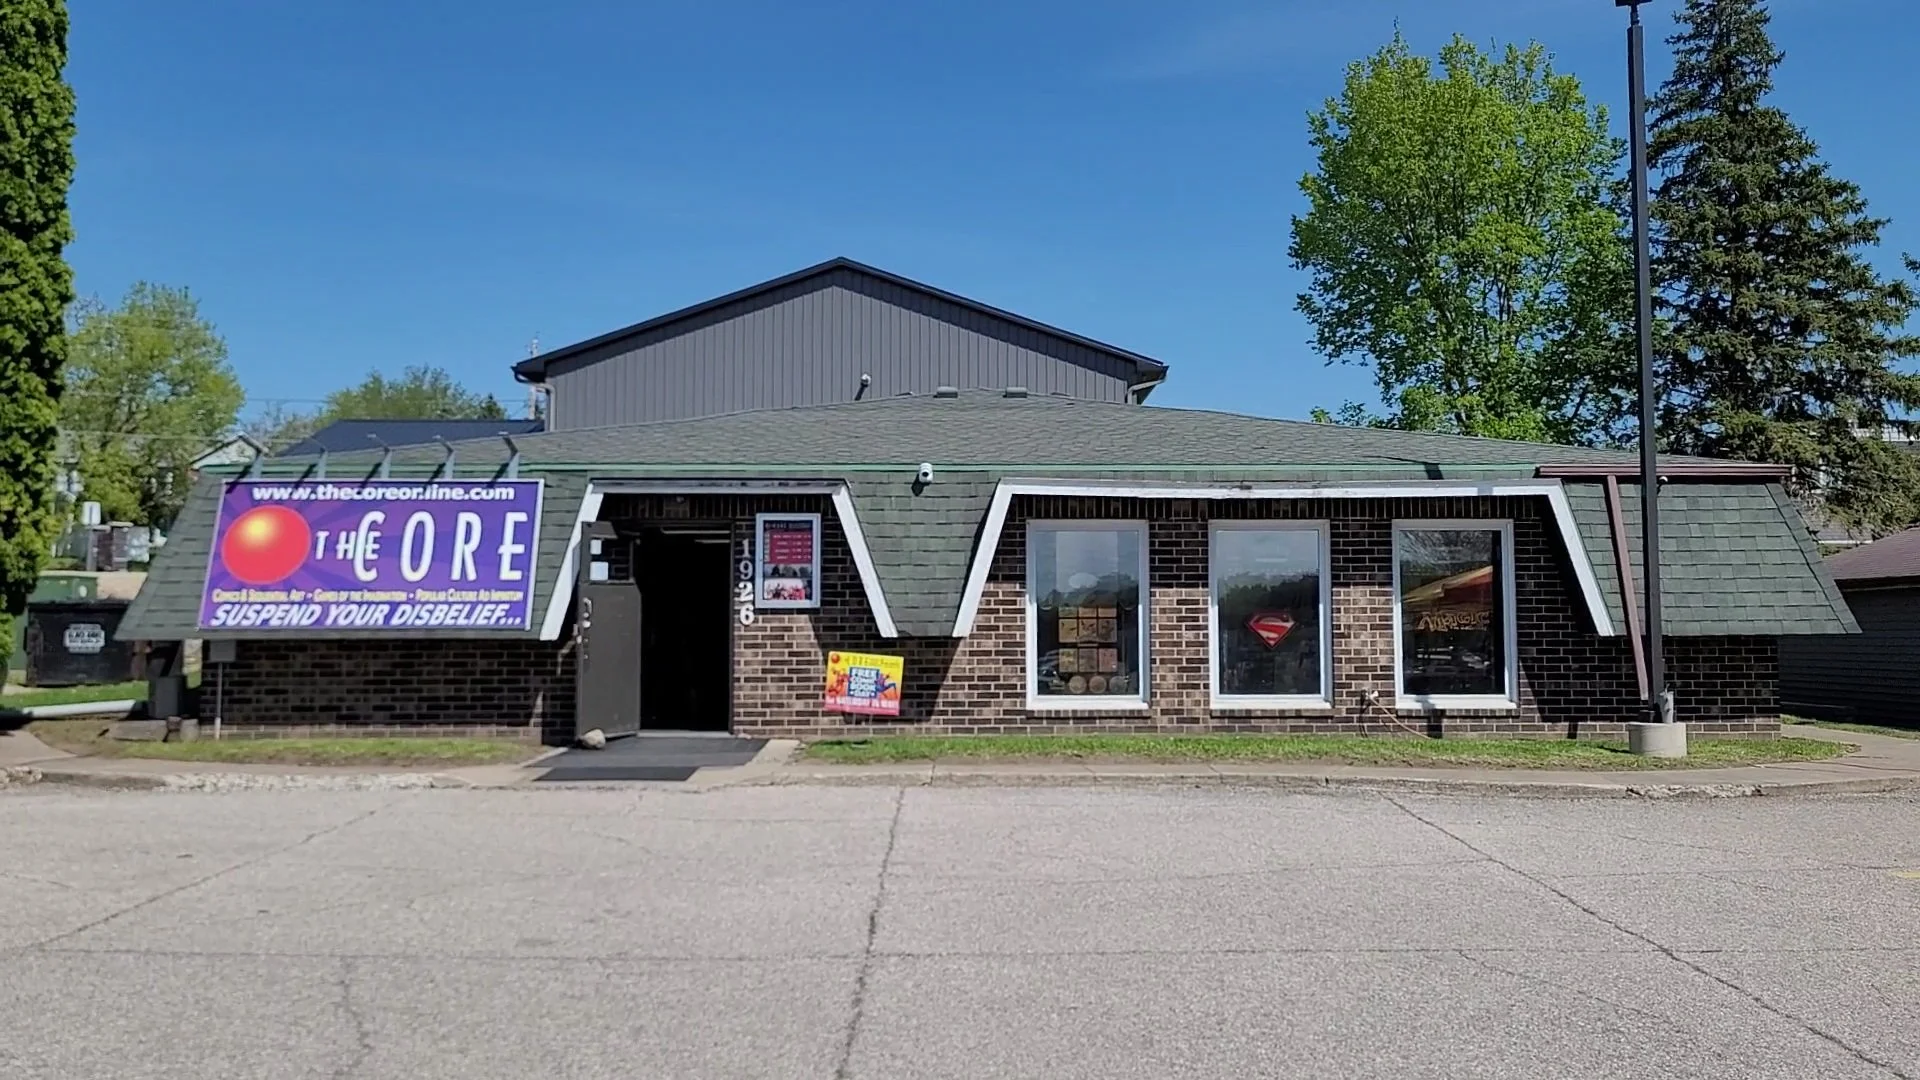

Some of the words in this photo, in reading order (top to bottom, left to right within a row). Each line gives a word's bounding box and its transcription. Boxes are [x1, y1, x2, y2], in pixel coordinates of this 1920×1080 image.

[315, 530, 382, 560] THE
[353, 510, 528, 582] CORE
[738, 538, 755, 626] 1926
[210, 603, 321, 626] SUSPEND
[323, 603, 388, 626] YOUR
[391, 603, 522, 626] DISBELIEF...
[851, 667, 877, 678] FREE
